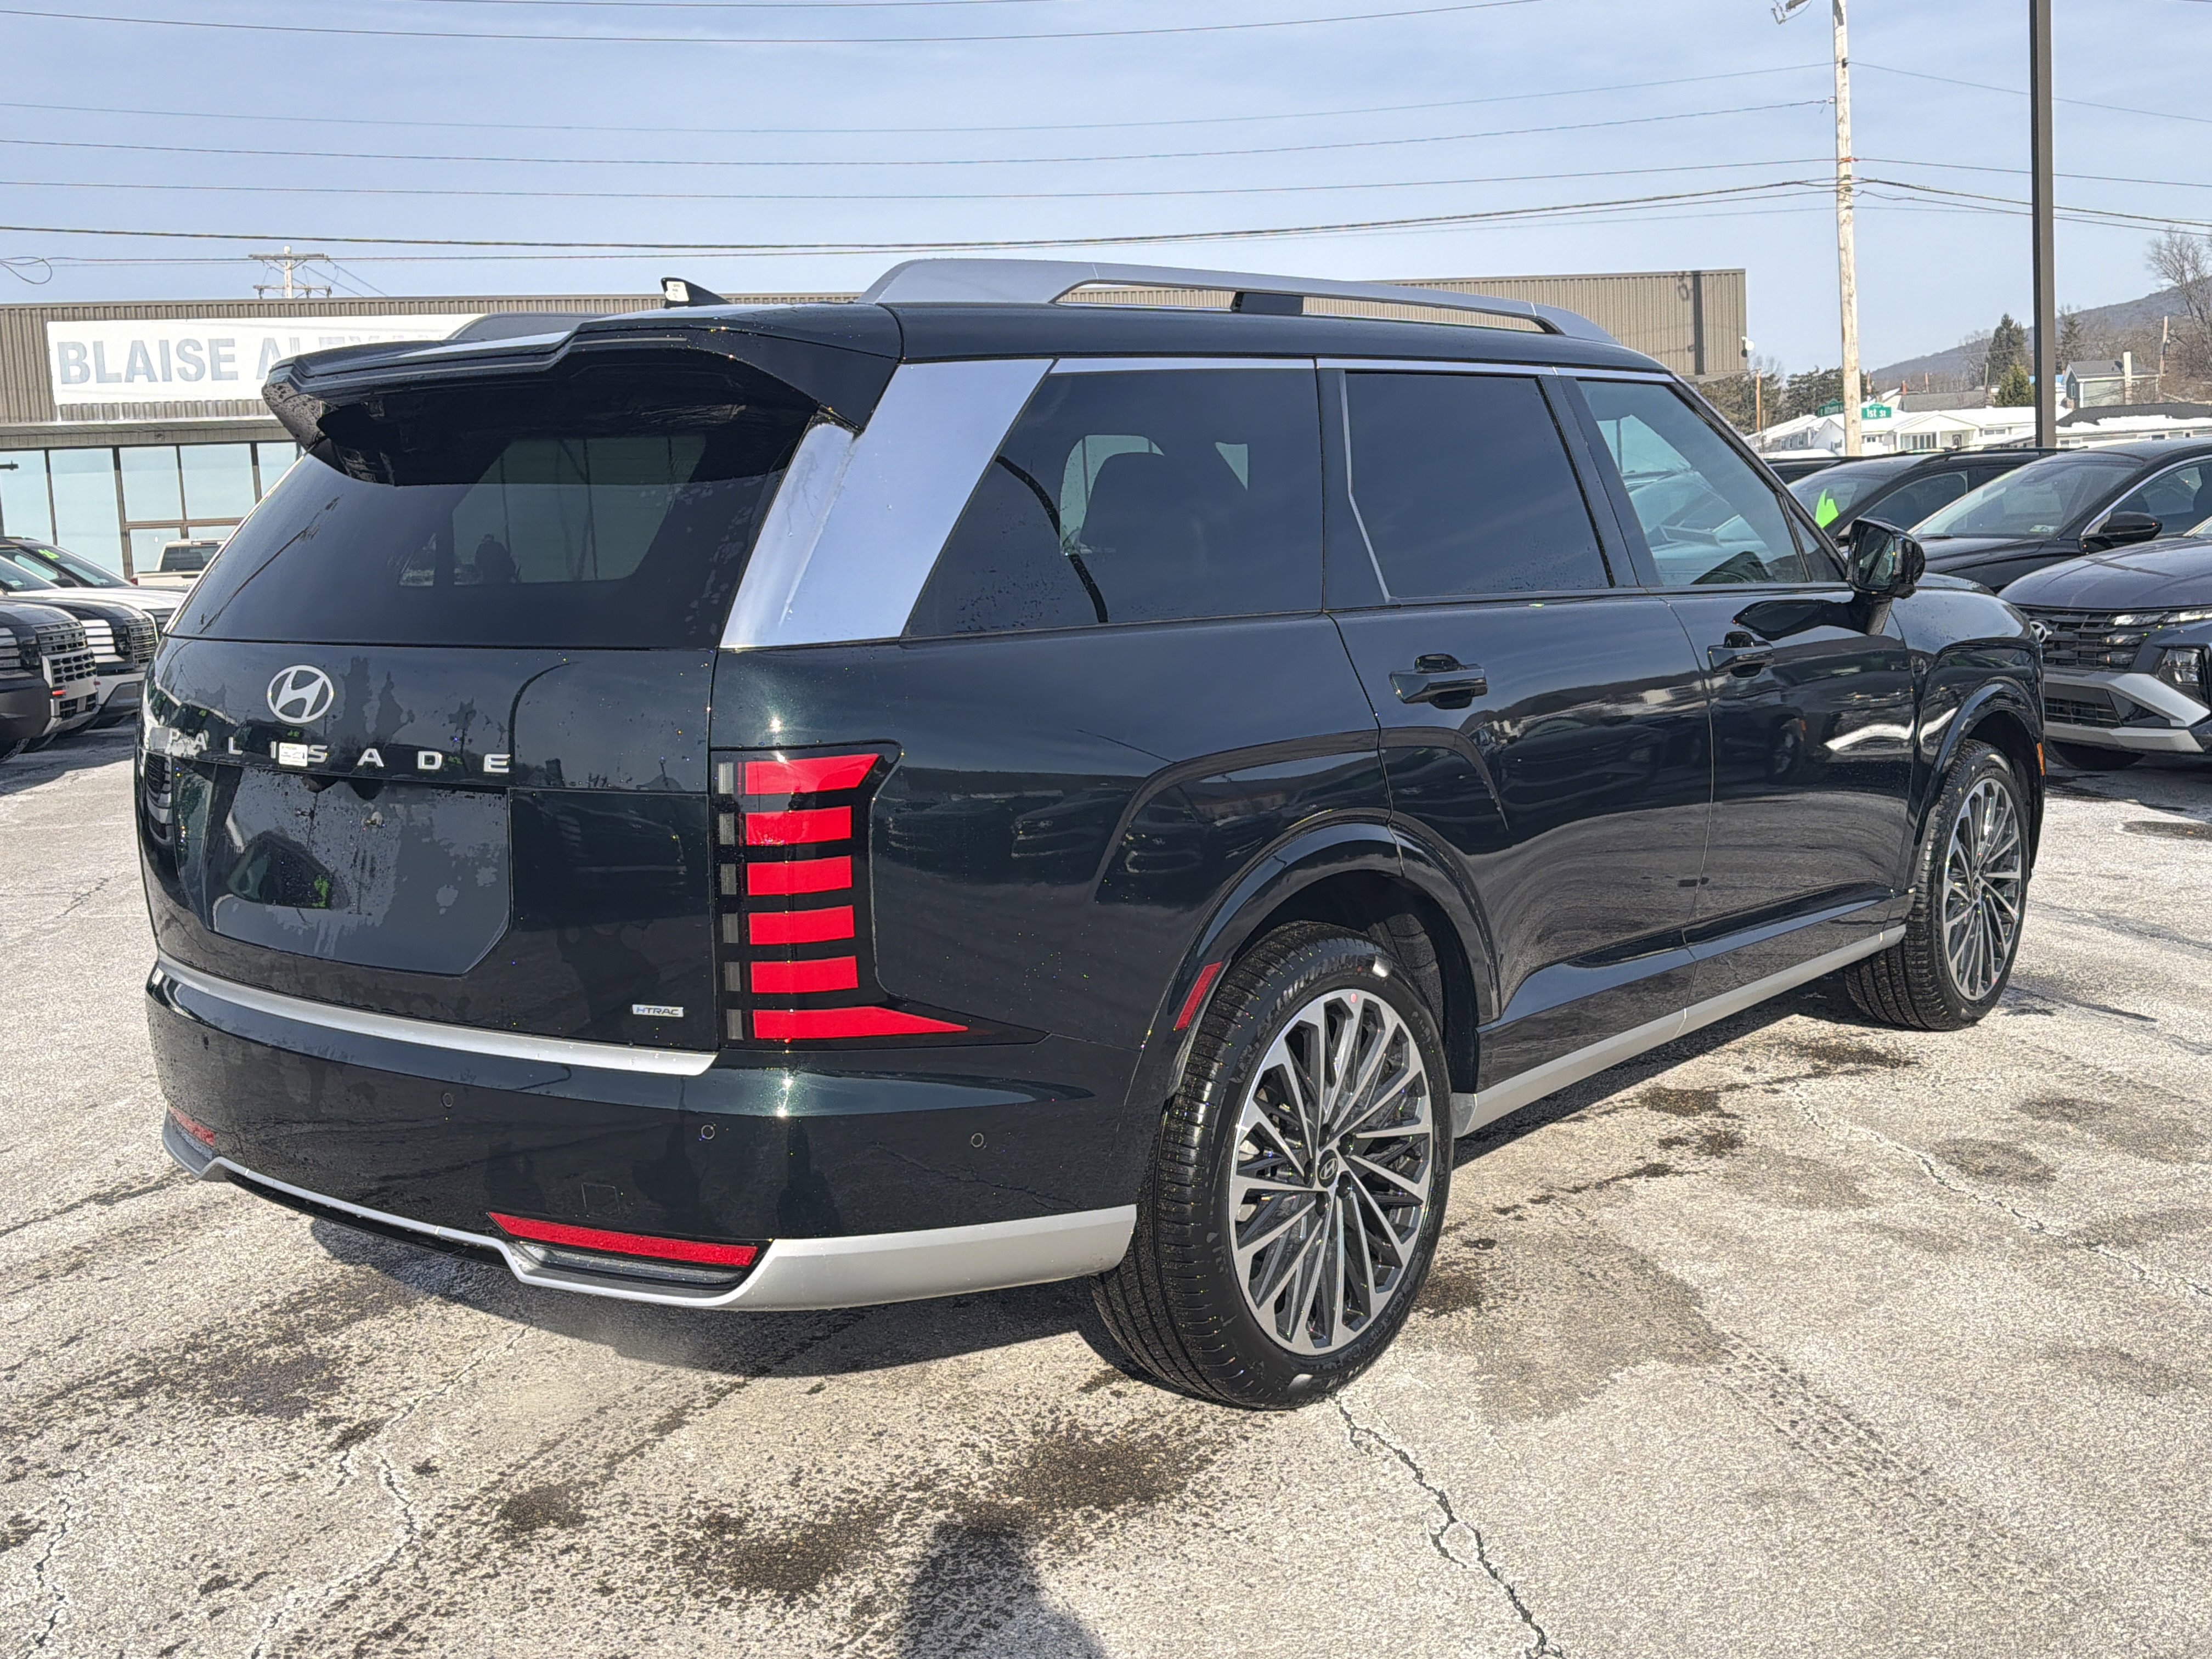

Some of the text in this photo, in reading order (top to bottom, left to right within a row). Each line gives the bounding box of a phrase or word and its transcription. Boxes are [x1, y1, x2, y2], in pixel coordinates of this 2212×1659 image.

[57, 338, 239, 384] BLAISE
[1866, 408, 1877, 417] 1st
[166, 727, 511, 773] PALISADE
[636, 1007, 680, 1015] HTRAC
